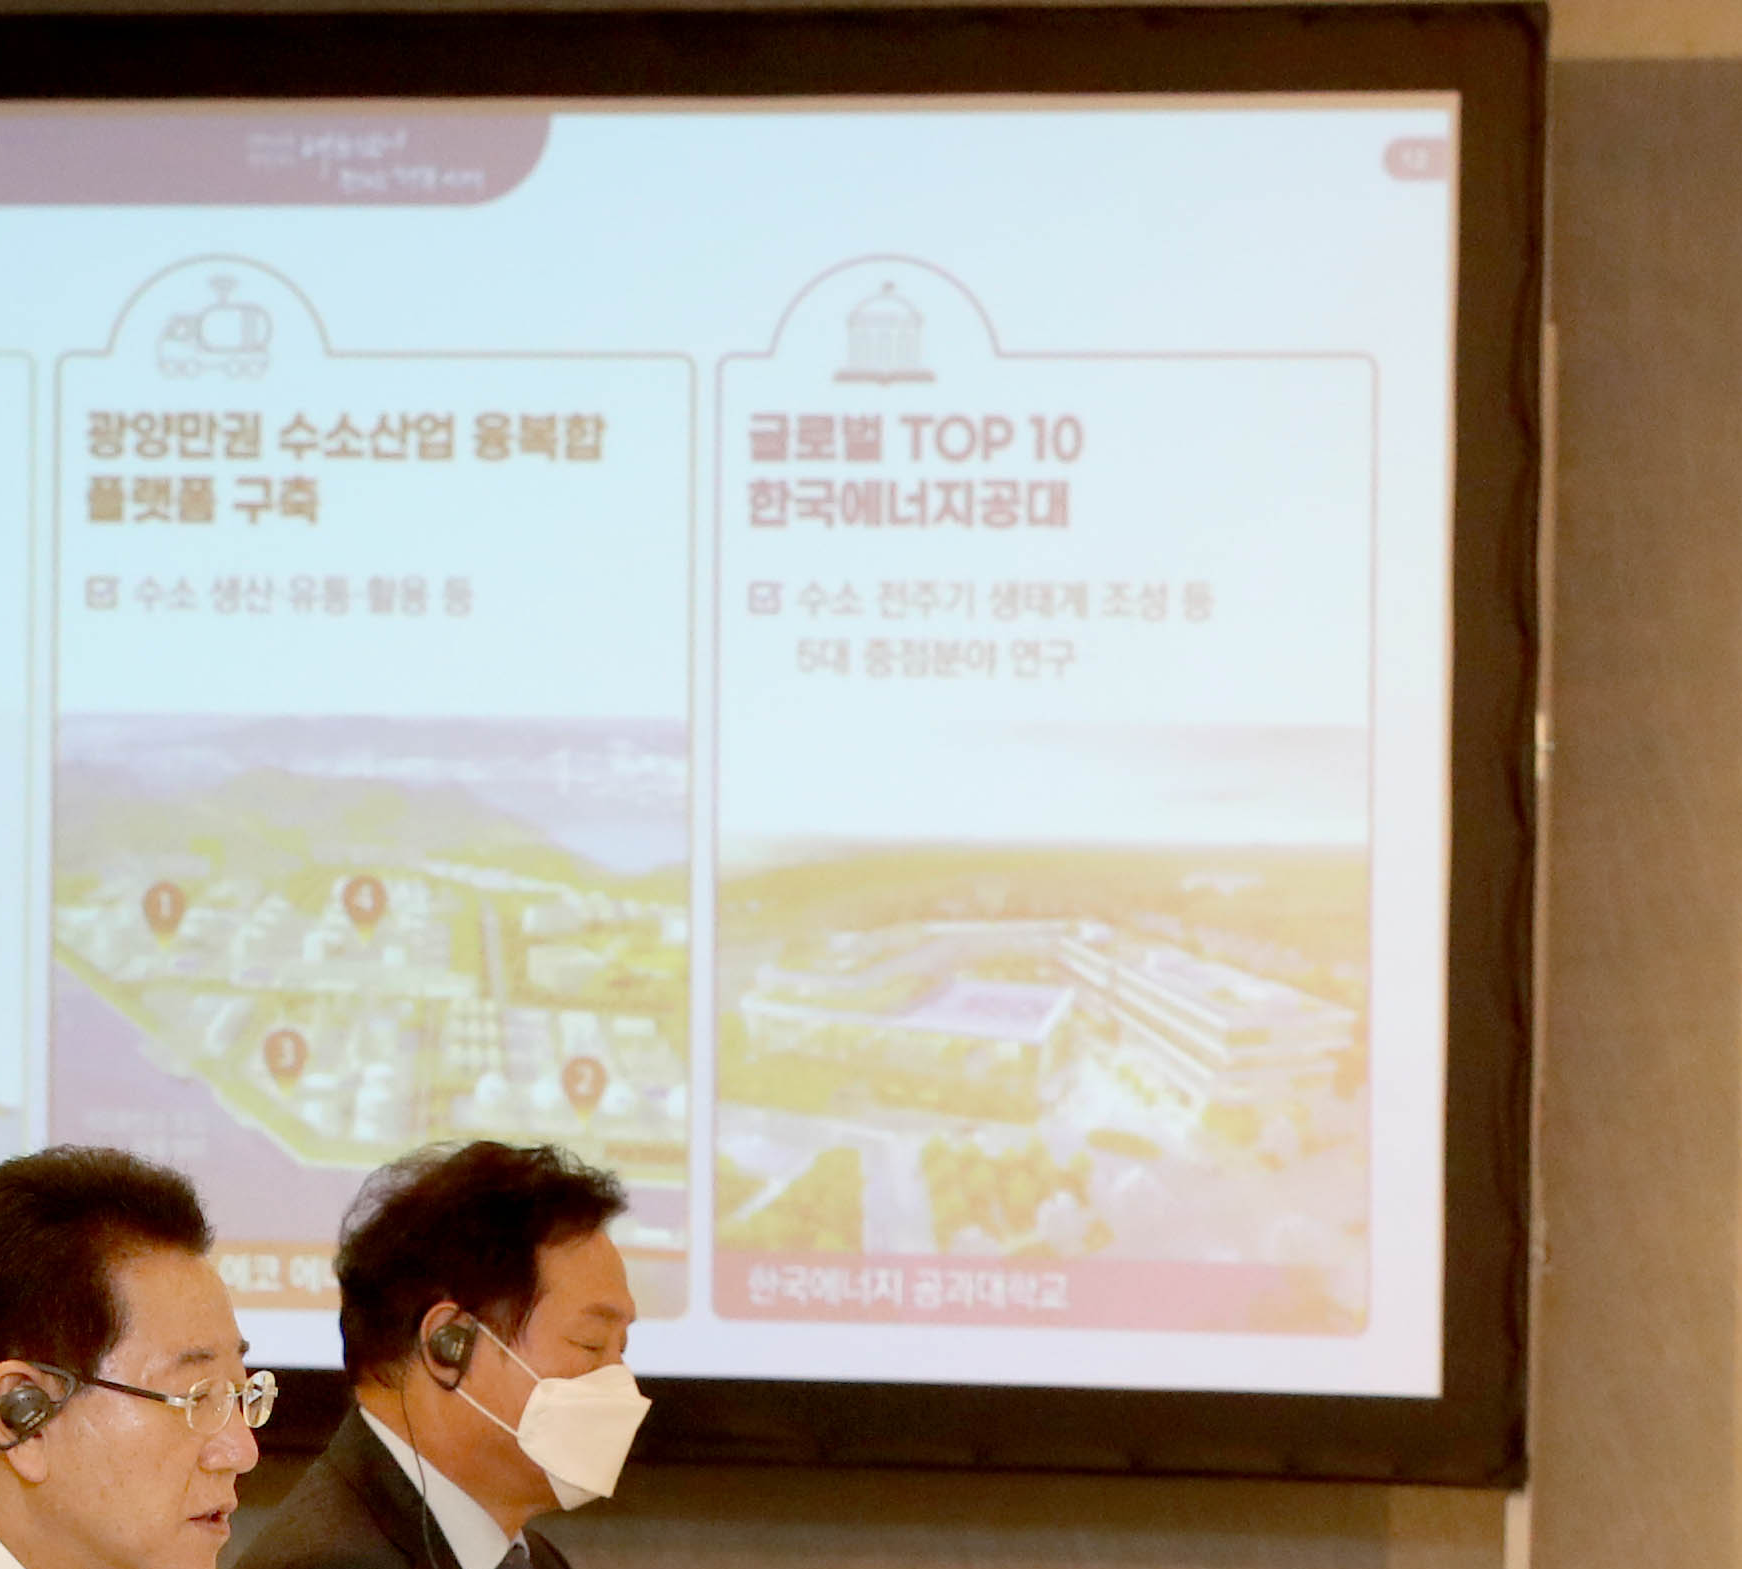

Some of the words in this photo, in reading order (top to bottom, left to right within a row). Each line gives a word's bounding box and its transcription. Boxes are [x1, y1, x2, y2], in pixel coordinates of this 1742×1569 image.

[86, 411, 262, 462] 광양만권
[278, 411, 455, 463] 수소산업
[473, 411, 606, 464] 융복합
[748, 413, 884, 464] 글로벌
[899, 413, 1016, 464] TOP
[1028, 413, 1085, 464] 10
[87, 474, 217, 525] 플랫폼
[234, 475, 320, 526] 구축
[747, 479, 1072, 531] 한국에너지공대
